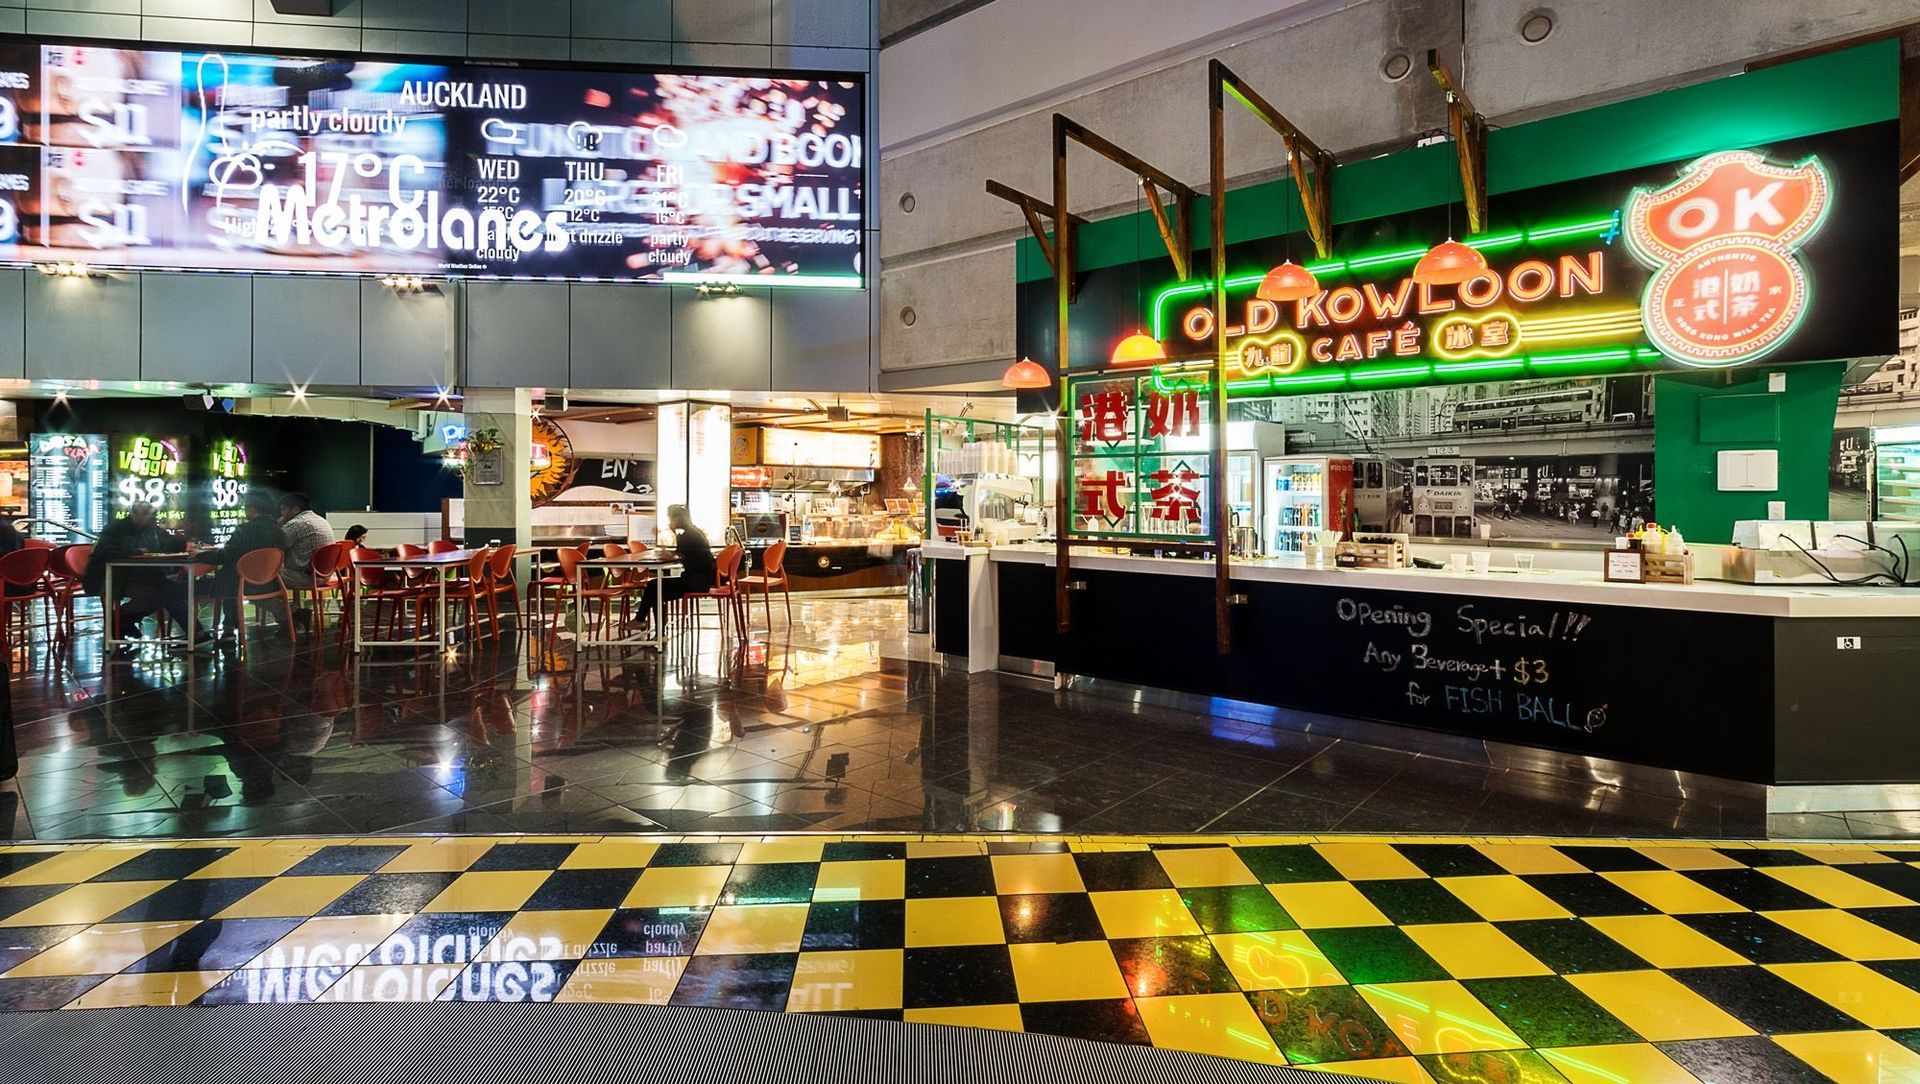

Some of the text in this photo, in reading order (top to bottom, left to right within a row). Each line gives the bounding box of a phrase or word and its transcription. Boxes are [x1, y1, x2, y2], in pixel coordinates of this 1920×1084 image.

[400, 80, 527, 110] AUCKLAND
[251, 105, 407, 136] partly cloudy
[297, 151, 426, 208] 17°C
[477, 158, 520, 180] WED
[565, 161, 605, 182] THU
[656, 164, 685, 185] FRI
[477, 186, 520, 204] 22°C
[564, 189, 606, 207] 20°C
[256, 184, 569, 252] Metrolanes
[570, 208, 600, 222] 12°C
[655, 211, 686, 225] 16°C
[1668, 181, 1786, 238] OK
[579, 228, 623, 245] drizzle
[651, 231, 690, 248] partly
[476, 246, 520, 263] cloudy
[648, 248, 692, 266] cloudy
[1697, 252, 1758, 271] AUTHENTIC
[1296, 251, 1604, 329] KOWLOON
[1445, 321, 1510, 348] 冰室
[1675, 306, 1778, 342] HONG KONG MILK TEA
[1311, 321, 1421, 363] CAFÉ
[133, 436, 163, 461] Go
[221, 439, 238, 463] Go
[1336, 598, 1431, 638] Opening
[1363, 641, 1401, 672] Any
[1513, 656, 1550, 685] $3
[1405, 681, 1582, 731] for FISH BALL
